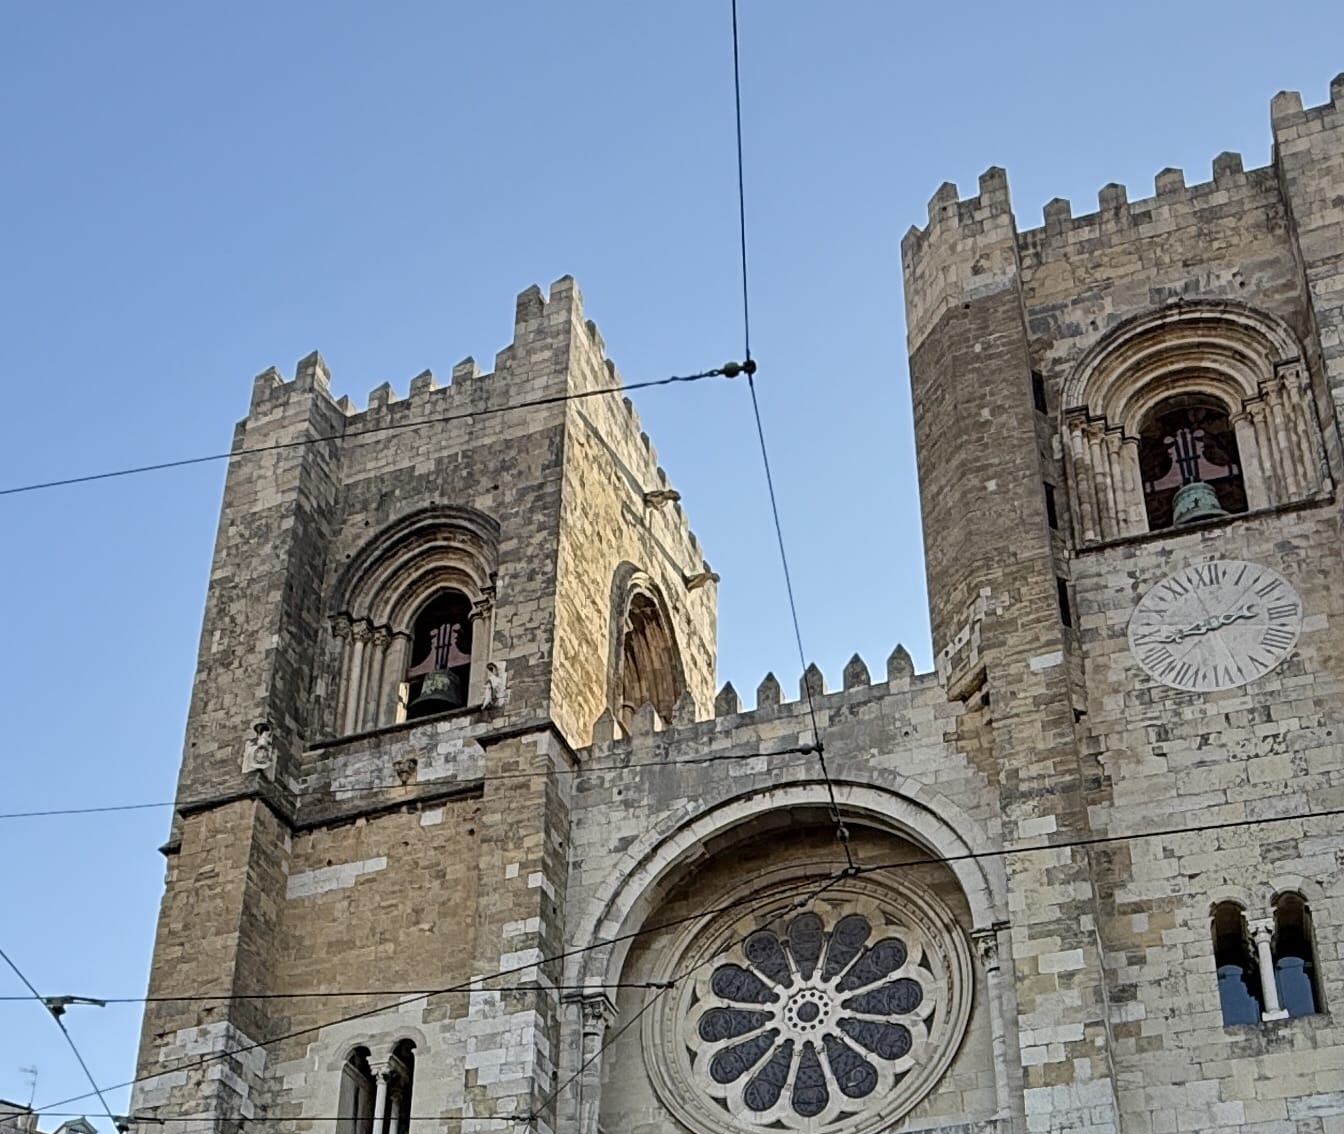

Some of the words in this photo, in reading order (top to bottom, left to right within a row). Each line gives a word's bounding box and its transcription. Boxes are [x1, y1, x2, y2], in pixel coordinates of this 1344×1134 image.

[1193, 563, 1220, 589] XII
[1233, 564, 1248, 586] I
[1161, 576, 1190, 601] XI
[1255, 577, 1284, 598] II
[1267, 603, 1299, 620] III
[1259, 627, 1296, 650] IIII
[1172, 661, 1200, 688] VII
[1248, 654, 1270, 674] V
[1213, 665, 1236, 688] VI
